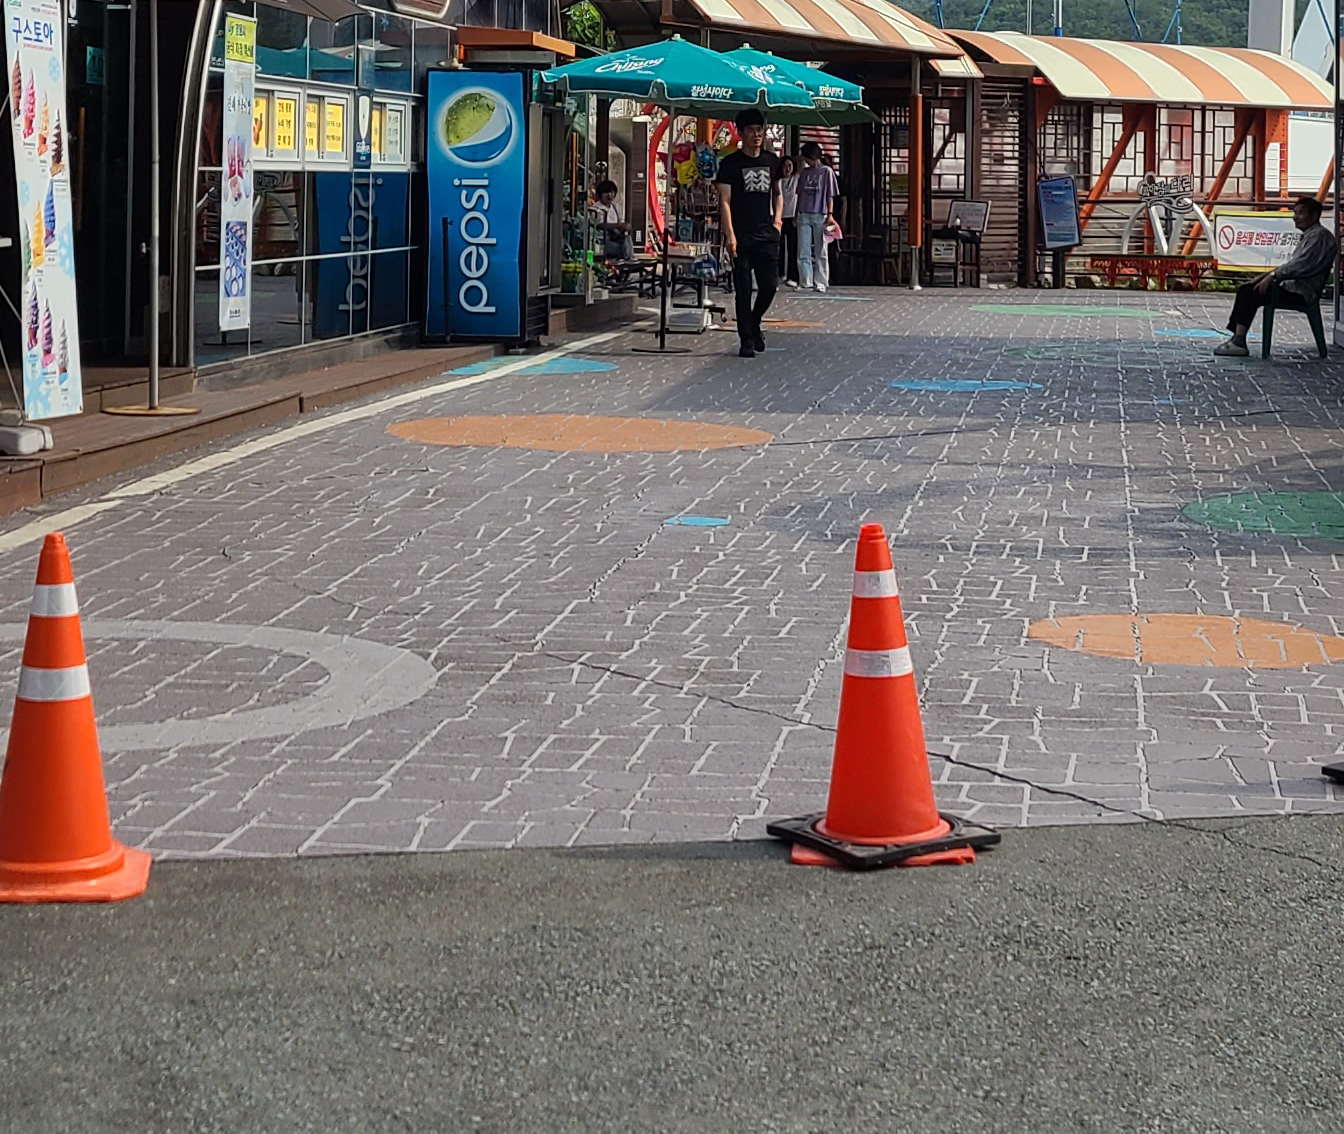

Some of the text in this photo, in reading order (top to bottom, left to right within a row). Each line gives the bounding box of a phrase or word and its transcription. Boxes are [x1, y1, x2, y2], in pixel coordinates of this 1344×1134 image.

[12, 16, 54, 46] 구스토아
[690, 83, 734, 99] 칠성사이다
[452, 178, 497, 314] pepsi
